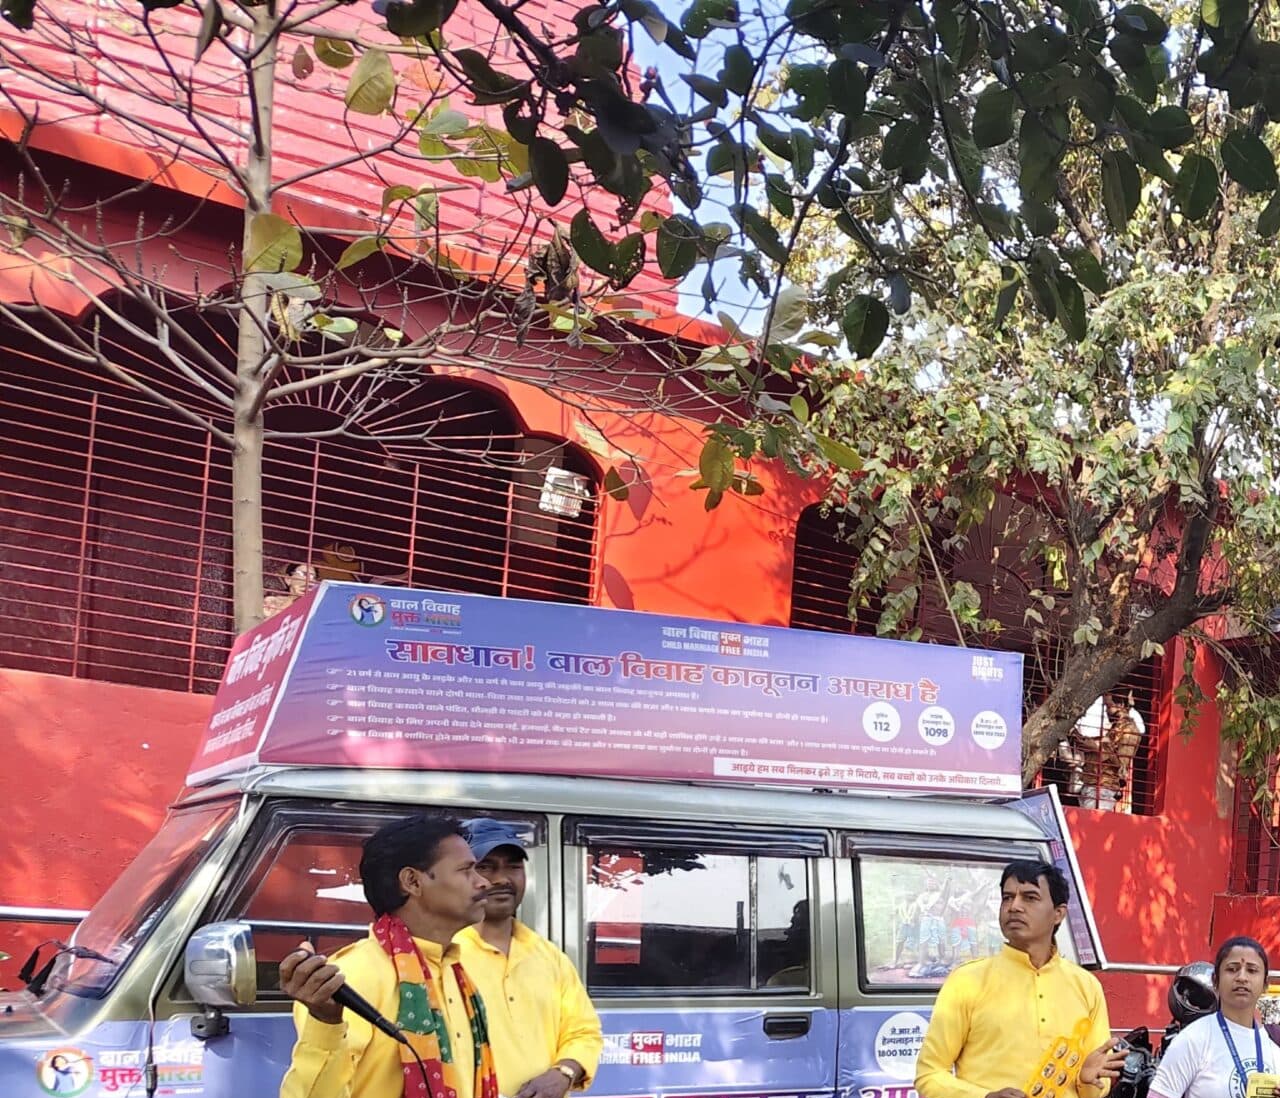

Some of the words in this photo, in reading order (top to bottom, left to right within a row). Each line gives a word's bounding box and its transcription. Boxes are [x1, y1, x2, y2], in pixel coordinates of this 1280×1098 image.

[390, 599, 418, 612] बाल
[422, 600, 461, 615] विवाह
[662, 627, 687, 639] बाल
[690, 628, 719, 641] विवाह
[720, 632, 741, 645] मुक्त
[662, 640, 682, 650] CHILD
[683, 642, 719, 653] MARRIAGE
[721, 644, 741, 655] FREE
[743, 647, 768, 658] INDIA
[972, 655, 994, 667] JUST
[385, 638, 535, 672] सावधान!
[547, 650, 614, 677] बाल
[619, 652, 707, 684] विवाह
[711, 665, 821, 697] कानूनन
[827, 676, 915, 703] अपराध
[917, 677, 941, 704] है
[971, 665, 1003, 679] RIGHTS
[873, 721, 890, 732] 112
[924, 727, 948, 738] 1098
[634, 1033, 663, 1050] मुक्त
[665, 1033, 702, 1048] भारत
[99, 1050, 139, 1066] बाल
[633, 1052, 662, 1064] FREE
[664, 1051, 701, 1063] INDIA
[878, 1049, 897, 1057] 1800
[899, 1049, 912, 1057] 102
[99, 1066, 142, 1091] मुक्त
